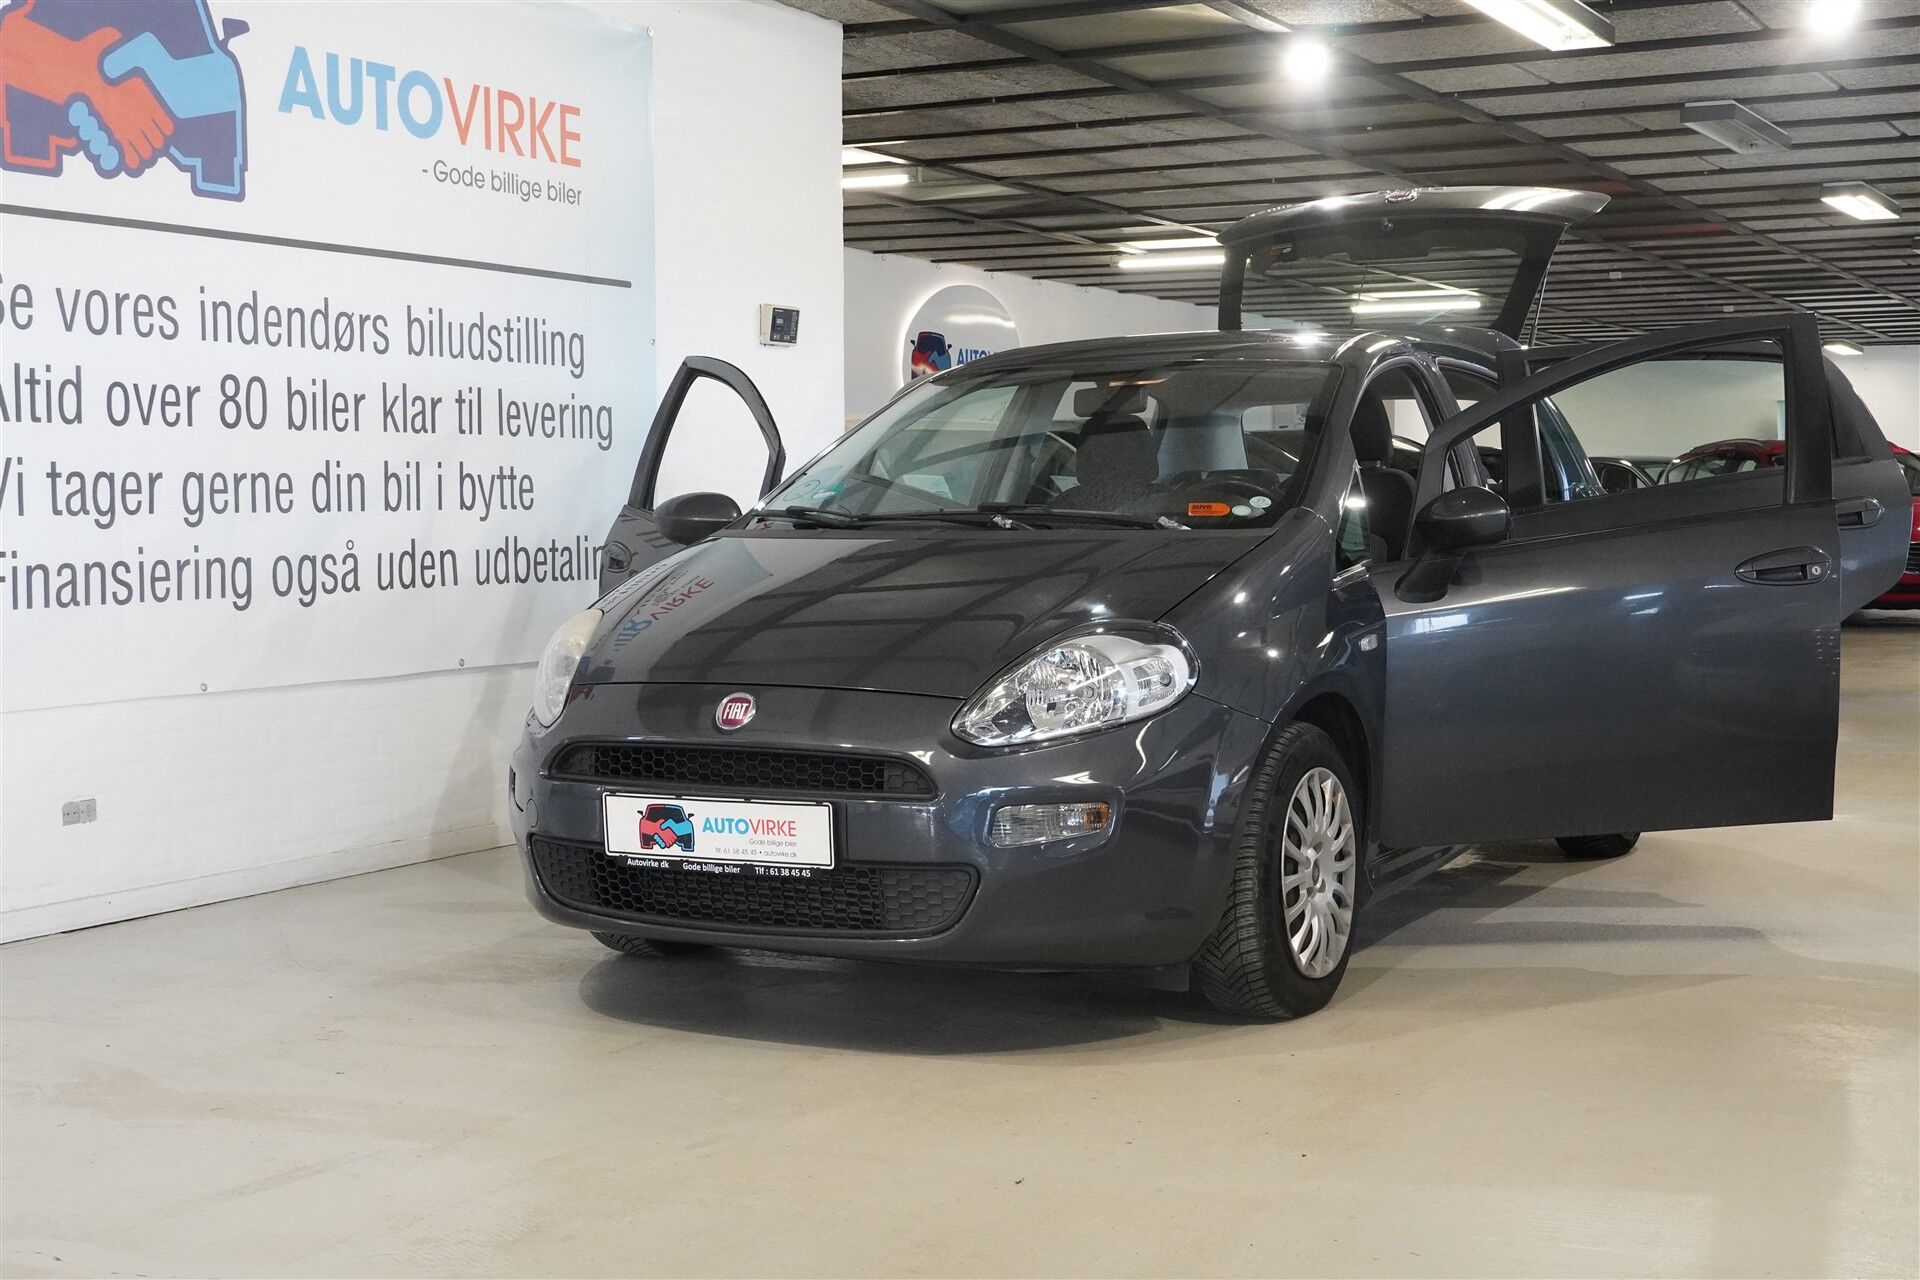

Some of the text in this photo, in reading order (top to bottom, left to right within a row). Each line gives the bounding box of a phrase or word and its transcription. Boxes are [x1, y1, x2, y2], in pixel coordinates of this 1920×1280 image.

[277, 45, 582, 168] AUTOVIRKE
[432, 159, 485, 190] Gode
[490, 169, 542, 202] billige
[546, 182, 582, 206] biler
[0, 274, 585, 380] e vores indendørs biludstilling
[957, 348, 990, 365] AUTO
[106, 381, 201, 428] over
[219, 373, 268, 430] 80
[286, 376, 366, 433] biler
[382, 382, 443, 435] klar
[454, 386, 482, 436] til
[497, 388, 613, 452] levering
[45, 461, 163, 530] tager
[182, 471, 294, 528] gerne
[311, 459, 366, 514] din
[383, 460, 421, 513] bil
[437, 461, 443, 511] i
[459, 461, 535, 522] bytte
[272, 539, 361, 608] også
[377, 538, 459, 591] uden
[475, 534, 603, 586] udbetalin
[723, 702, 749, 720] FIAT
[702, 816, 797, 837] AUTOVIRKE
[748, 838, 766, 846] Gode
[627, 857, 659, 868] Autovirke
[660, 860, 670, 868] dk
[682, 862, 702, 871] Gode
[702, 863, 724, 874] billige
[724, 865, 741, 874] biler
[769, 867, 779, 876] 61
[780, 868, 790, 876] 38
[790, 868, 800, 877] 45
[801, 869, 811, 878] 45
[741, 848, 749, 856] 45
